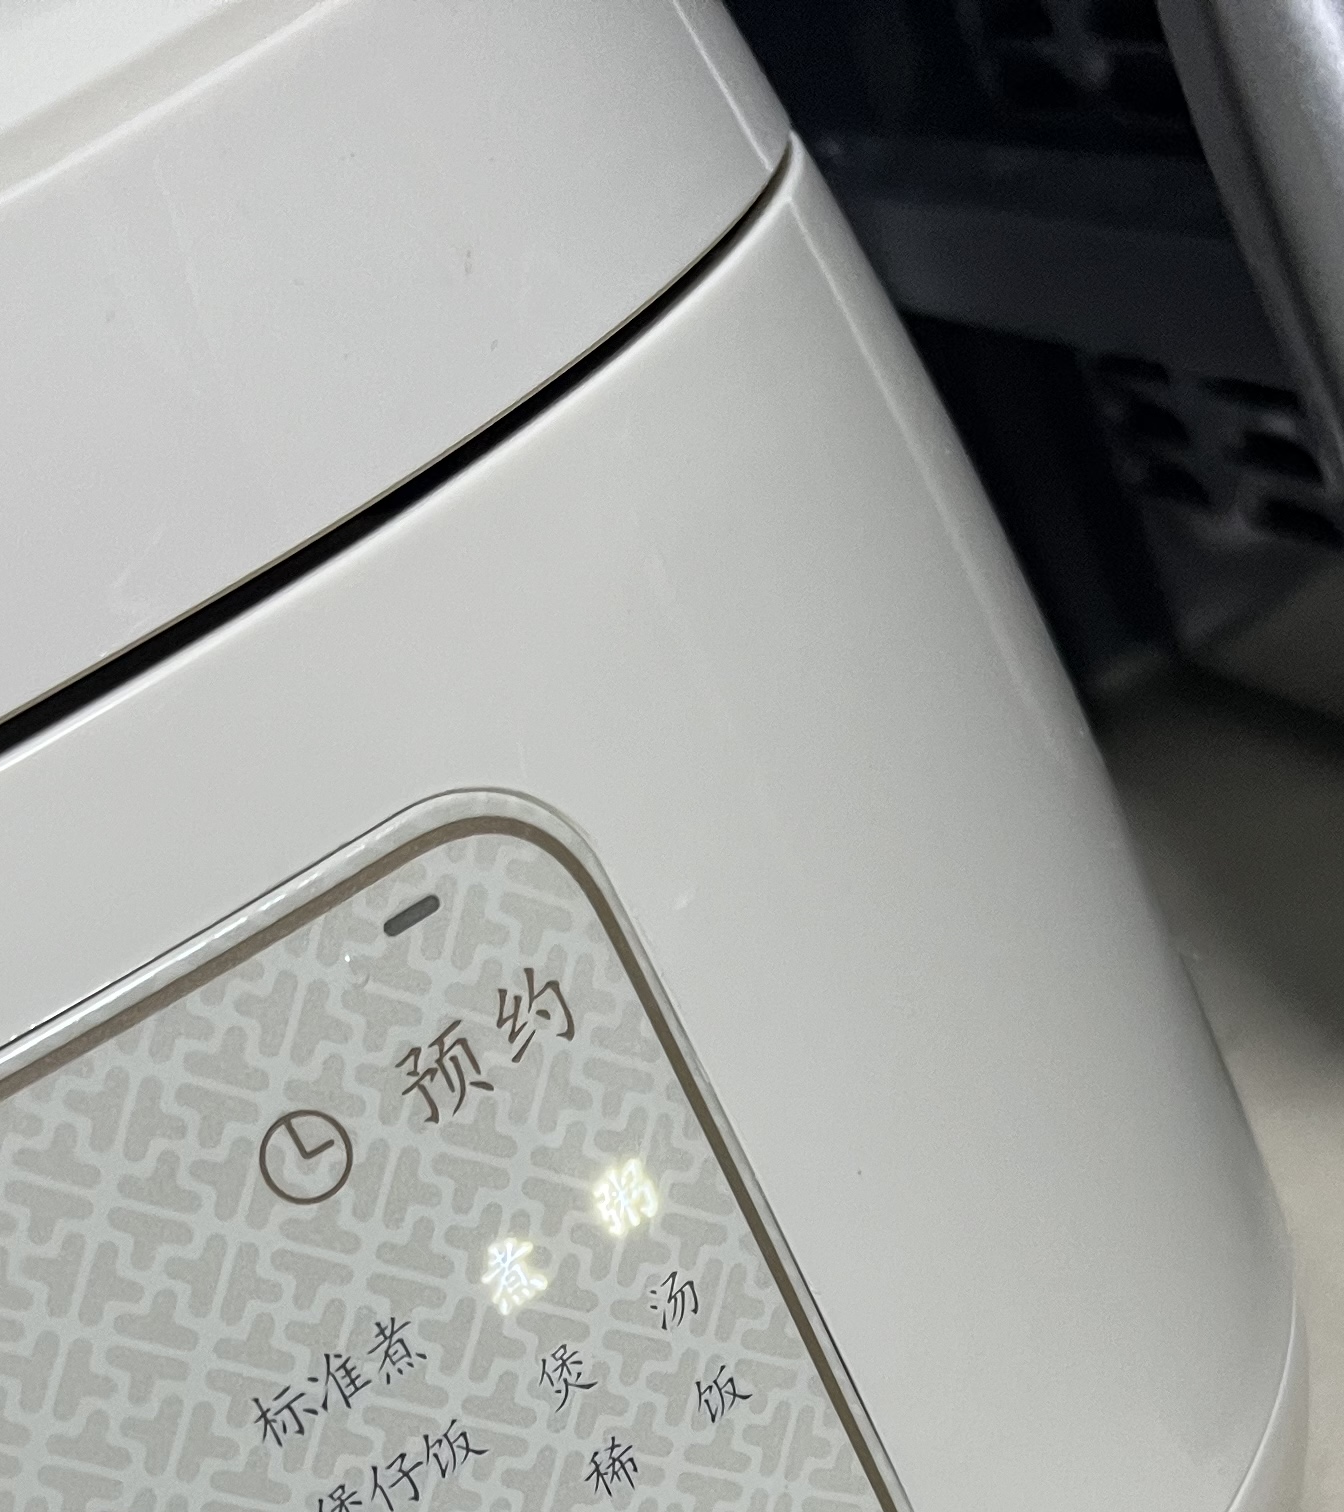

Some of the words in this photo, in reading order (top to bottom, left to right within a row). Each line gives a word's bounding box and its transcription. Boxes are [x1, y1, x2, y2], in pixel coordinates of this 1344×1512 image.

[395, 967, 575, 1124] 预约
[482, 1157, 657, 1315] 煮粥
[253, 1316, 427, 1447] 标准煮
[538, 1270, 699, 1412] 煲汤
[585, 1365, 752, 1498] 稀饭
